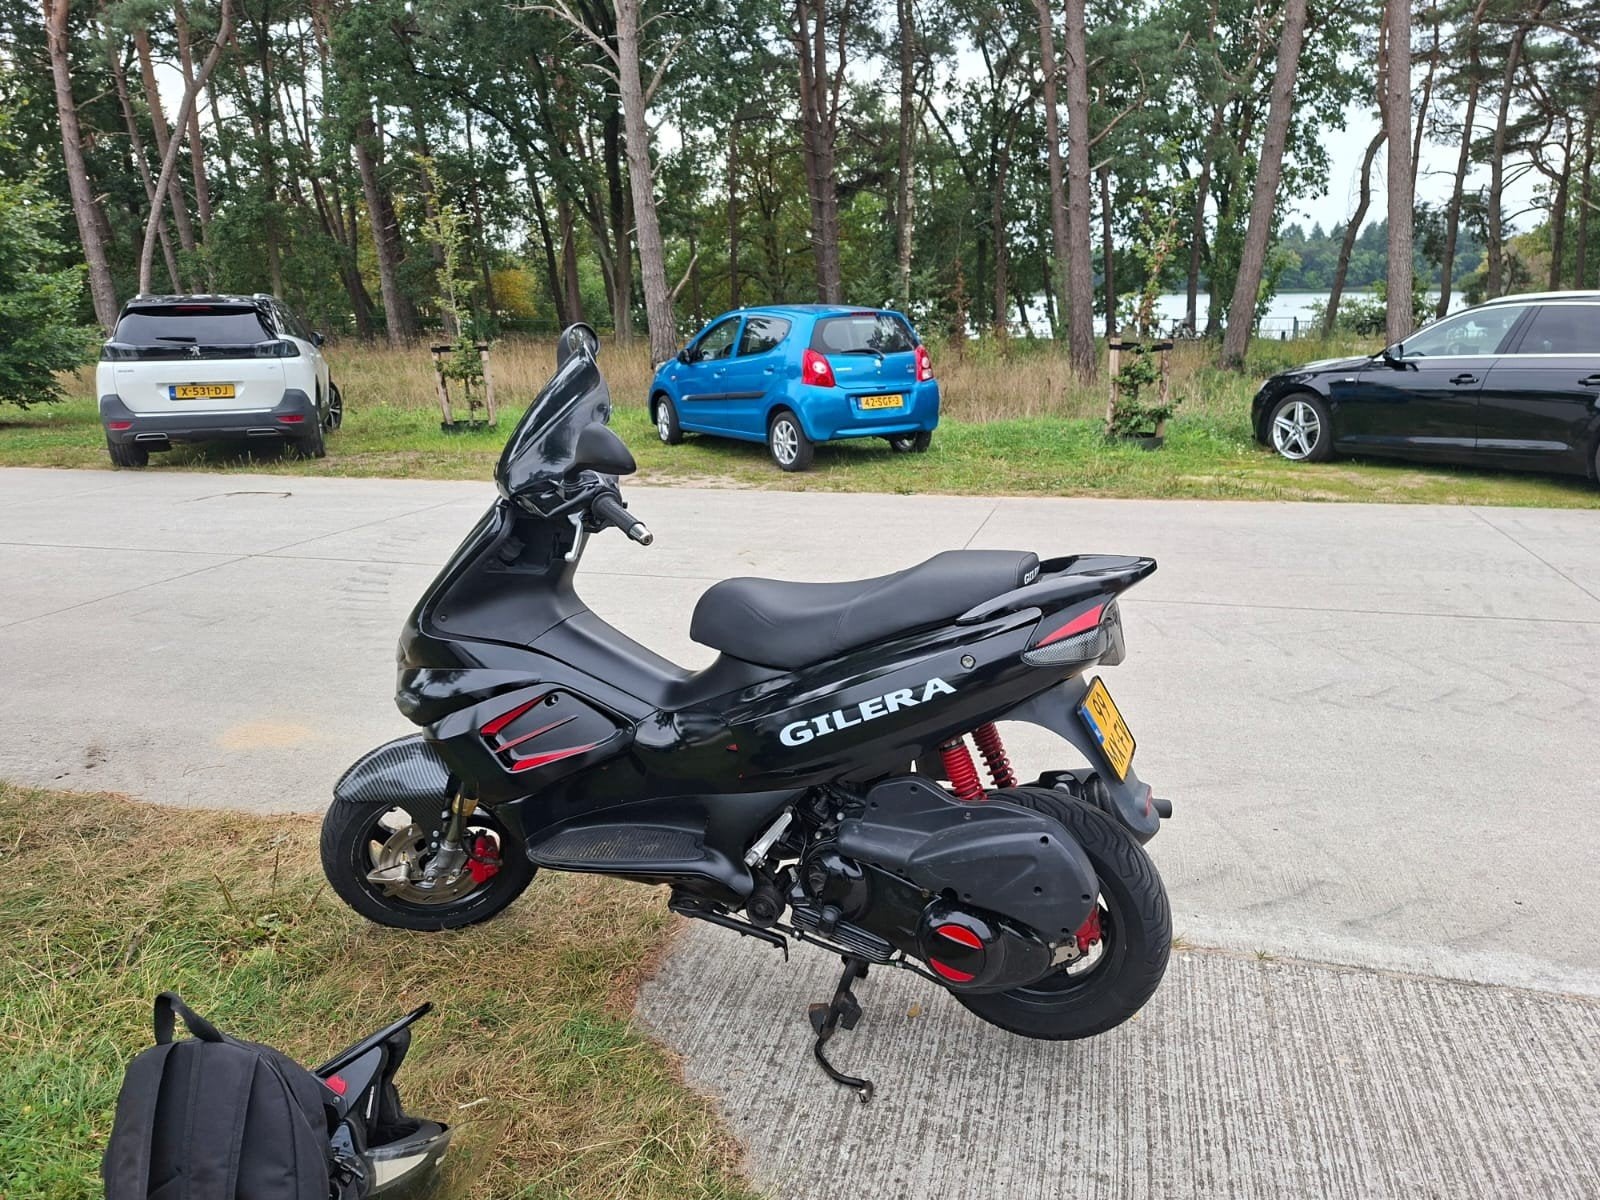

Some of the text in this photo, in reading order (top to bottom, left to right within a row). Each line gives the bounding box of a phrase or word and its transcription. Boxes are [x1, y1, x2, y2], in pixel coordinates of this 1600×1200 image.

[181, 386, 228, 396] X-531-DJ
[779, 677, 957, 746] GILERA
[1092, 691, 1110, 726] 99
